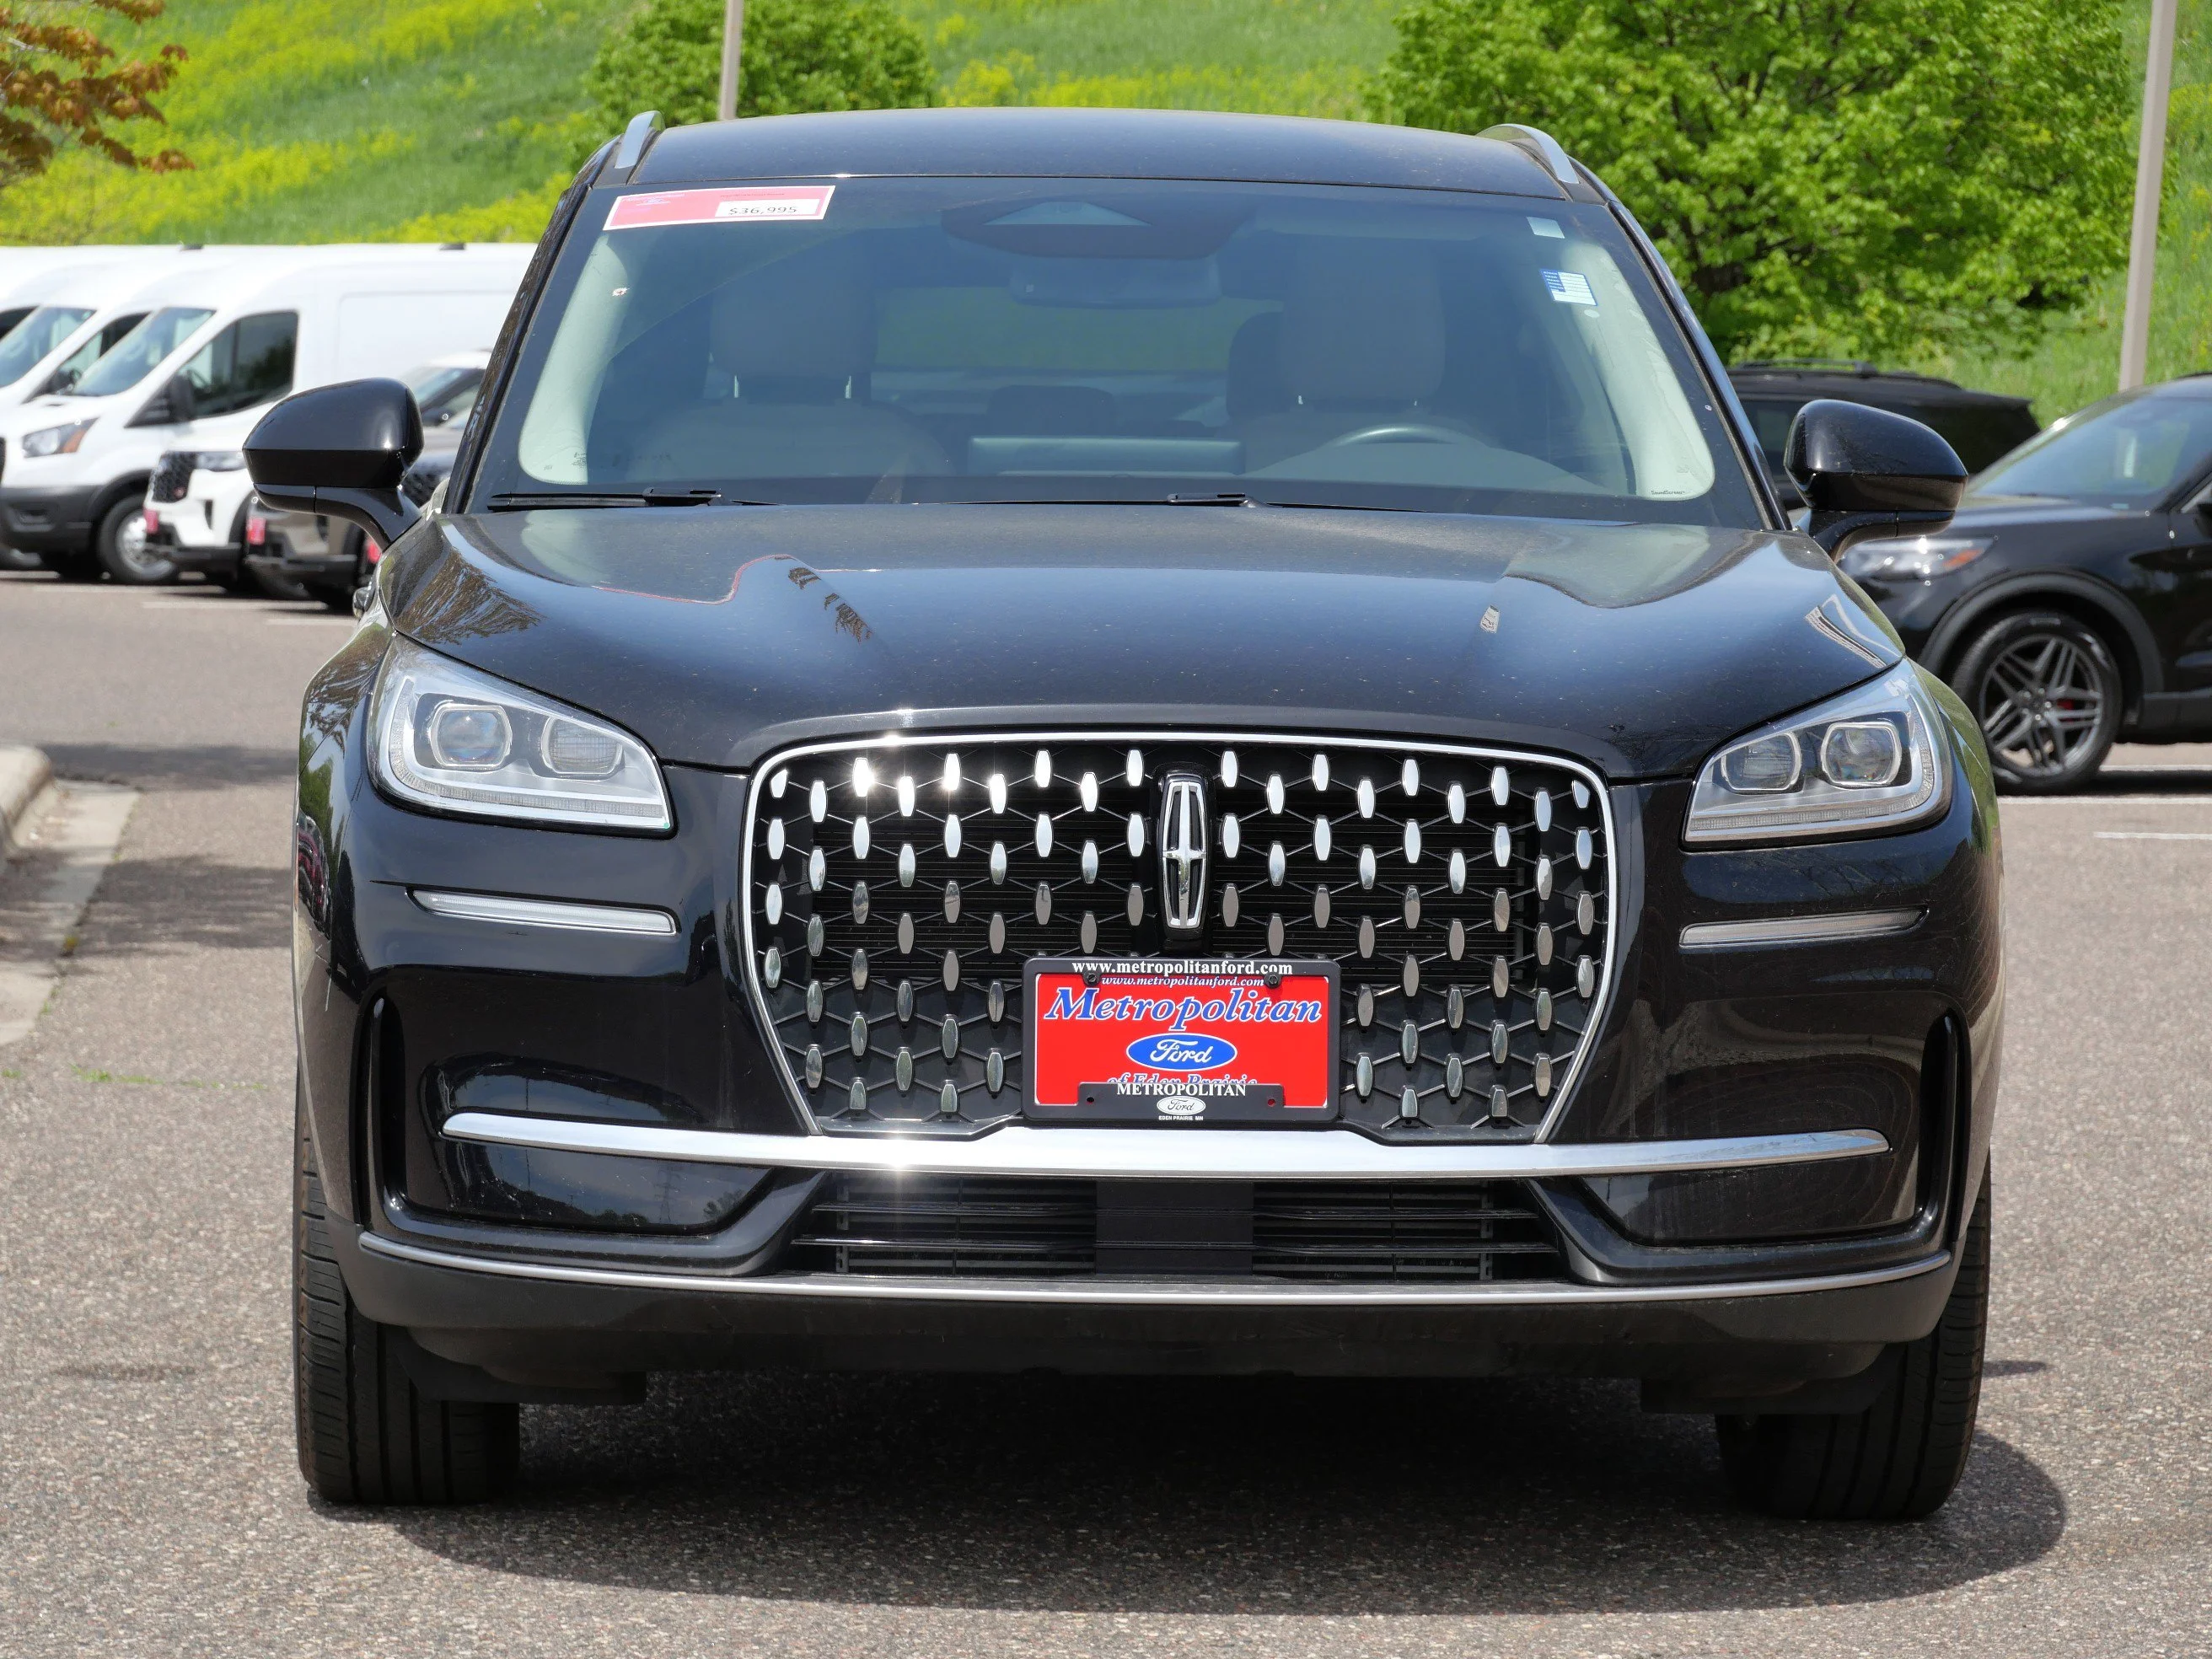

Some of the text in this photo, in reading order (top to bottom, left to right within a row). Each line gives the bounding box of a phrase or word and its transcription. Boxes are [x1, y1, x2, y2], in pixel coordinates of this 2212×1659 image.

[1072, 959, 1293, 977] www.metropolitanford.com
[1102, 975, 1264, 986] www.metropolitanford.com
[1044, 987, 1322, 1031] Metropolitan
[1150, 1039, 1212, 1063] Ford
[1117, 1083, 1246, 1096] METROPOLITAN
[1167, 1098, 1195, 1111] Ford
